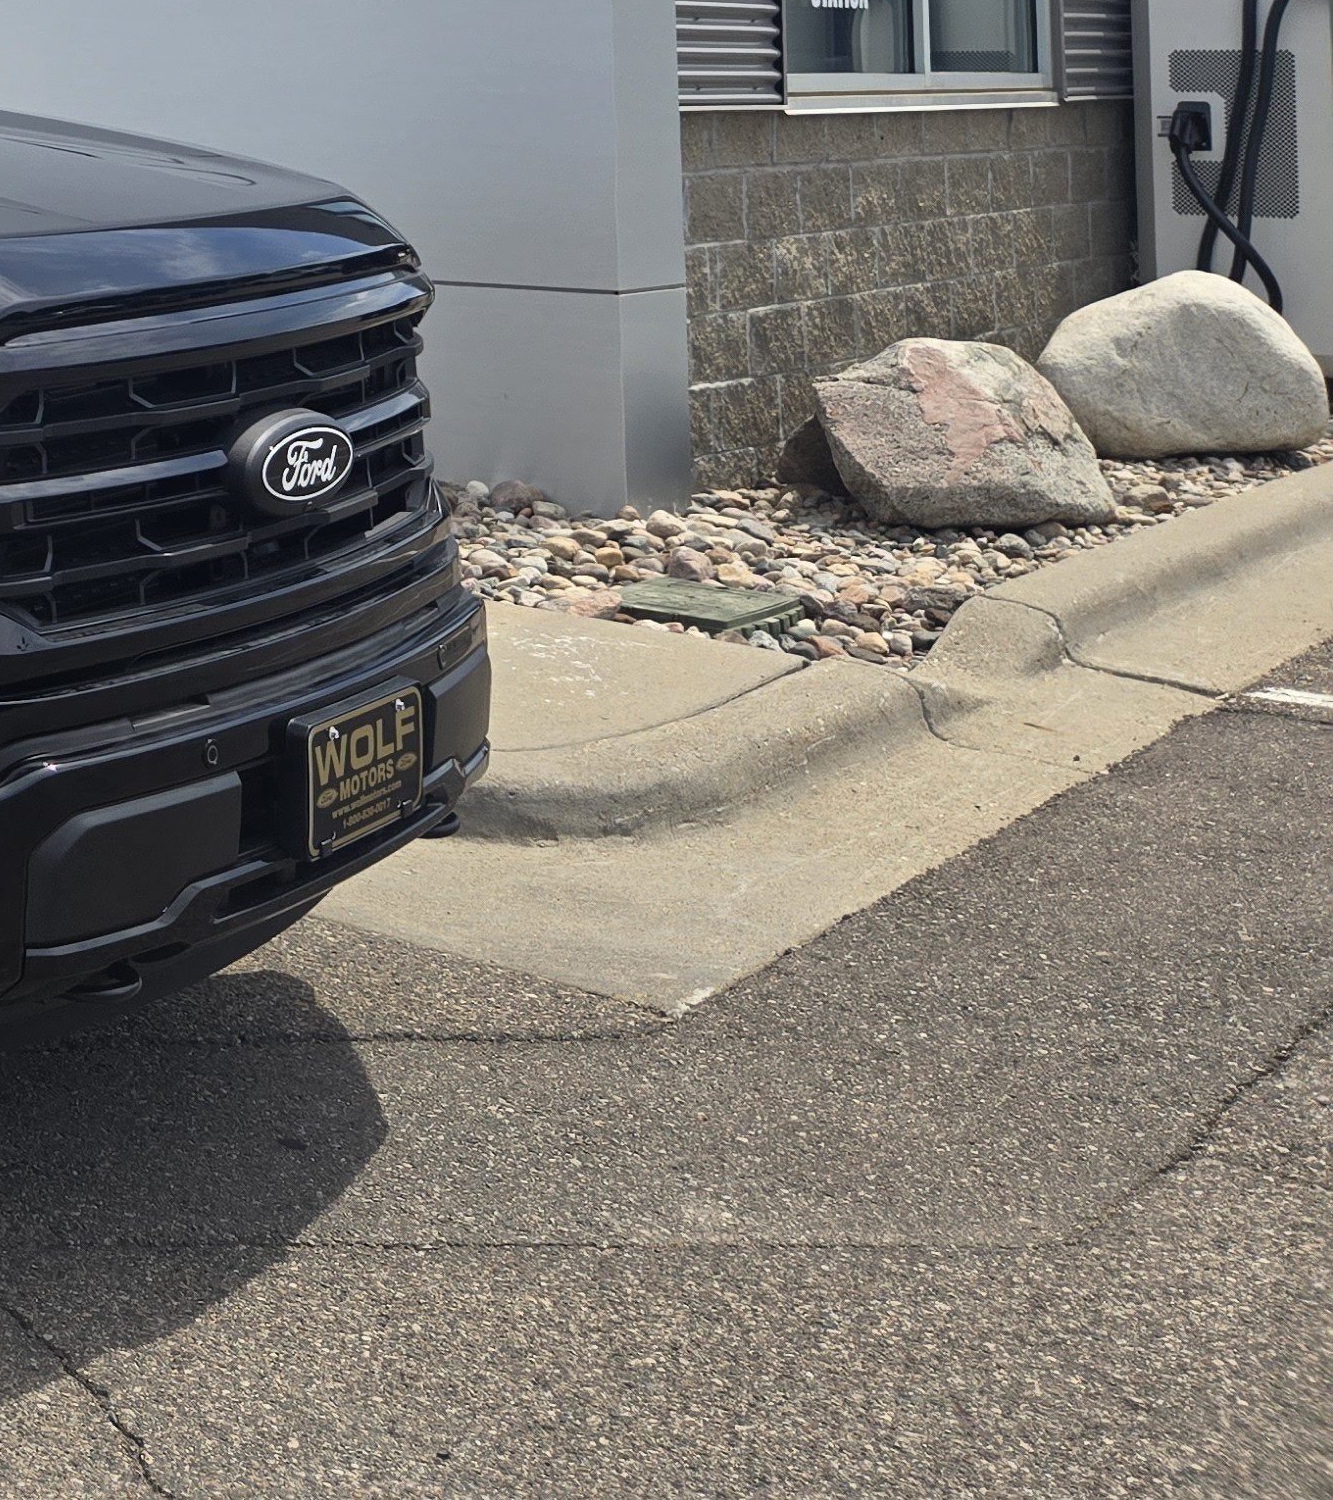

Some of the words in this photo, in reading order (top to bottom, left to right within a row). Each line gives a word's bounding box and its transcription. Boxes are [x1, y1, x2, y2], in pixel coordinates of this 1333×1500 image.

[282, 438, 338, 492] Ford
[315, 706, 416, 786] WOLF
[339, 759, 395, 801] MOTORS
